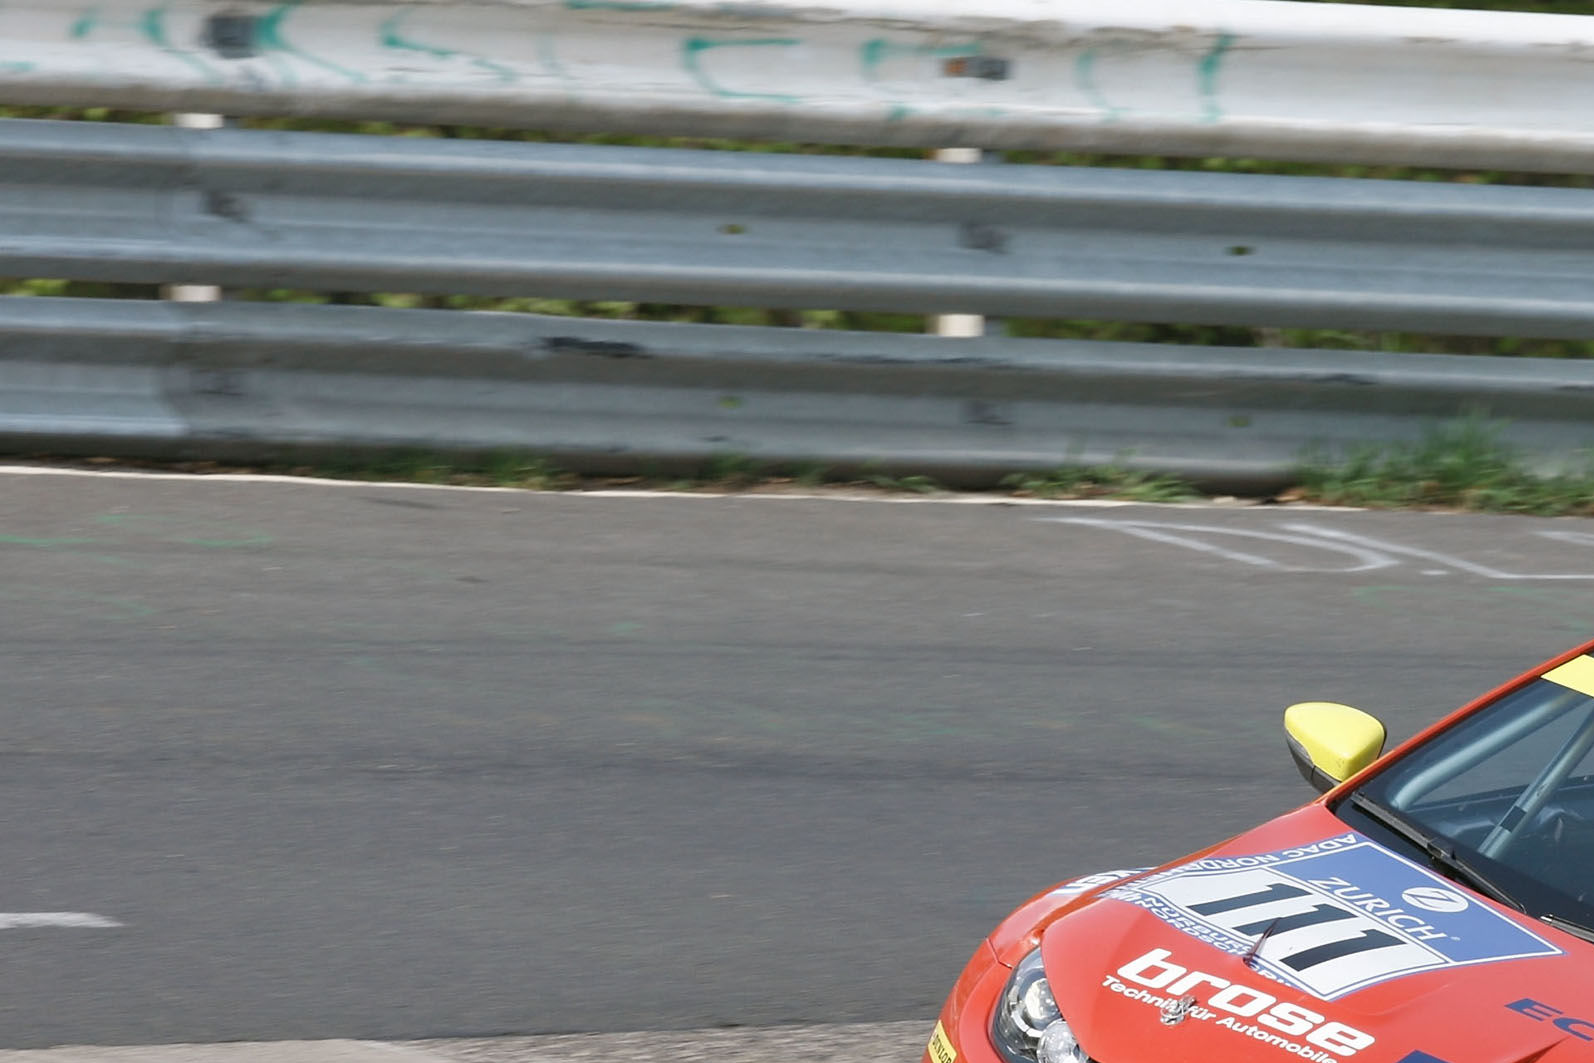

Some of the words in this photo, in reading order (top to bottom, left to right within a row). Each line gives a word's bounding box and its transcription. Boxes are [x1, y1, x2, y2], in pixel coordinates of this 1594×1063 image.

[1282, 832, 1358, 858] ADAC
[1186, 882, 1408, 972] 111
[1308, 876, 1447, 941] ZURICH
[1117, 948, 1375, 1056] brose
